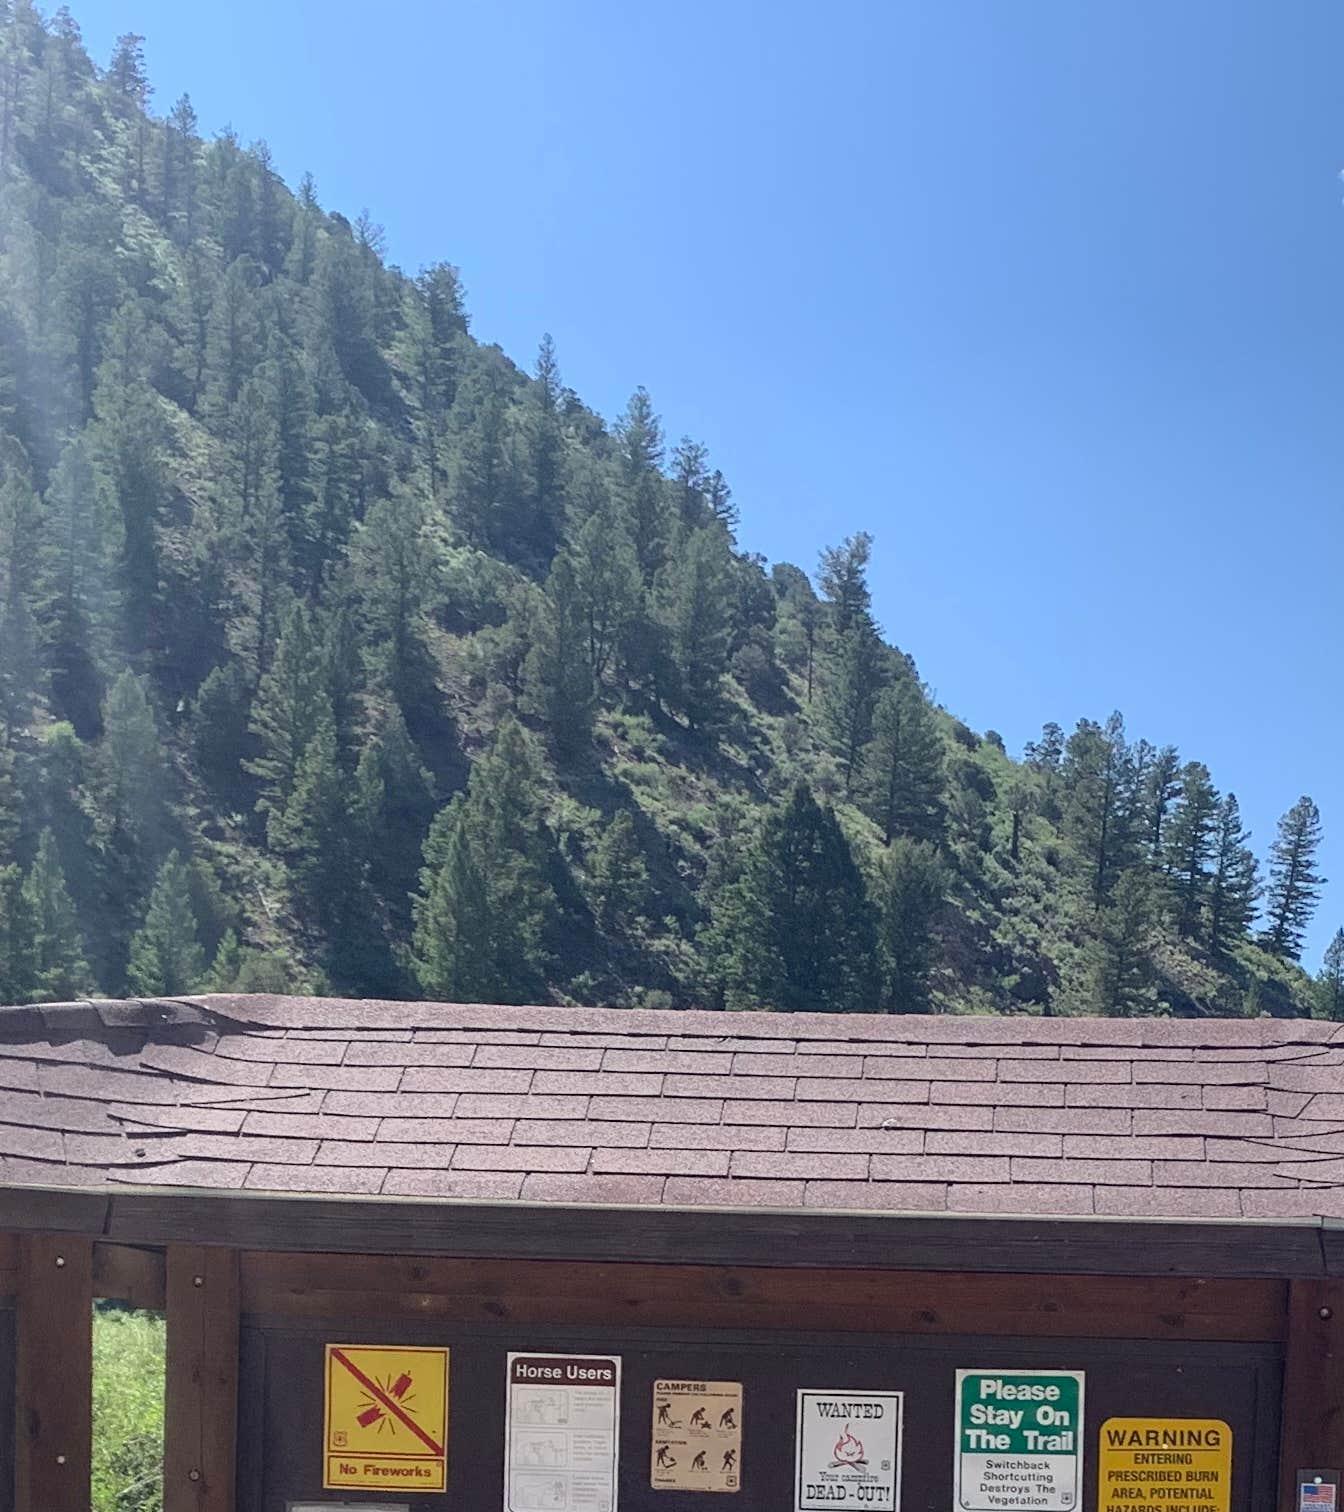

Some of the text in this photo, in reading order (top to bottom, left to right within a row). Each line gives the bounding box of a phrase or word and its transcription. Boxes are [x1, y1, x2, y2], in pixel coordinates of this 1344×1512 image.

[516, 1364, 612, 1380] Horse Users
[657, 1383, 707, 1391] CAMPERS
[980, 1379, 1060, 1400] Please
[817, 1403, 884, 1419] WANTED
[970, 1404, 1070, 1429] Stay On
[965, 1429, 1073, 1451] The Trail
[1107, 1430, 1220, 1446] WARNING
[1134, 1453, 1192, 1464] ENTERING
[340, 1463, 431, 1477] No Fireworks
[986, 1460, 1050, 1470] Switchback
[819, 1472, 839, 1482] Your
[984, 1472, 1053, 1483] Shortcutting
[1108, 1471, 1219, 1482] PRESCRIBED BURN
[980, 1484, 1056, 1494] Destroys The
[1112, 1488, 1214, 1500] AREA, POTENTIAL
[988, 1496, 1048, 1505] Vegetation
